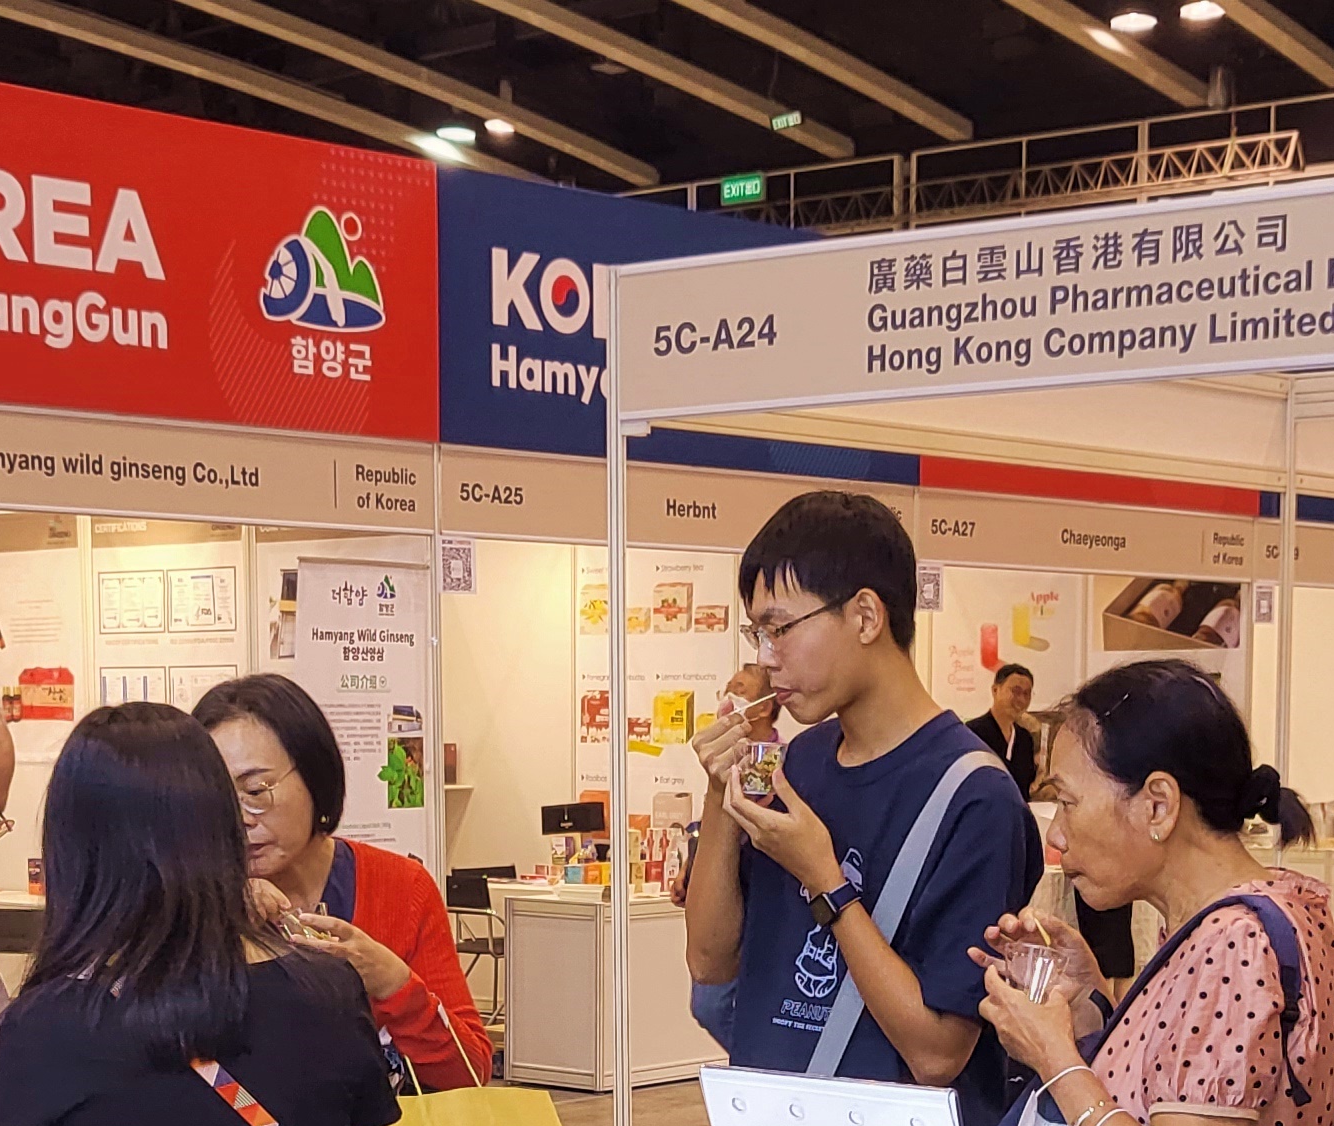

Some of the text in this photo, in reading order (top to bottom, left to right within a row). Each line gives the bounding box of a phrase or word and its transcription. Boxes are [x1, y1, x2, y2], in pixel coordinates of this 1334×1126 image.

[723, 182, 746, 198] EXIT
[867, 213, 1289, 295] 廣藥白雲山香港有限公司
[866, 286, 1039, 333] Guangzhou
[1047, 259, 1314, 318] Pharmaceutical
[652, 313, 778, 357] 5C-A24
[866, 338, 943, 375] Hong
[953, 329, 1033, 367] Kong
[1043, 316, 1198, 360] Company
[290, 335, 373, 382] 함양군
[61, 453, 104, 476] wild
[109, 457, 186, 486] ginseng
[192, 462, 260, 488] Co.,Ltd
[355, 464, 417, 486] Republic
[356, 492, 417, 513] of Korea
[458, 482, 525, 507] 5C-A25
[665, 498, 718, 521] Herbnt
[94, 521, 147, 534] CERTIFICATIONS
[930, 518, 976, 539] 5C-A27
[1060, 528, 1127, 550] Chaeyeonga
[1212, 532, 1246, 548] Republic
[1212, 553, 1244, 566] of Korea
[1031, 592, 1058, 604] Apple
[311, 627, 414, 647] Hamyang Wild Ginseng
